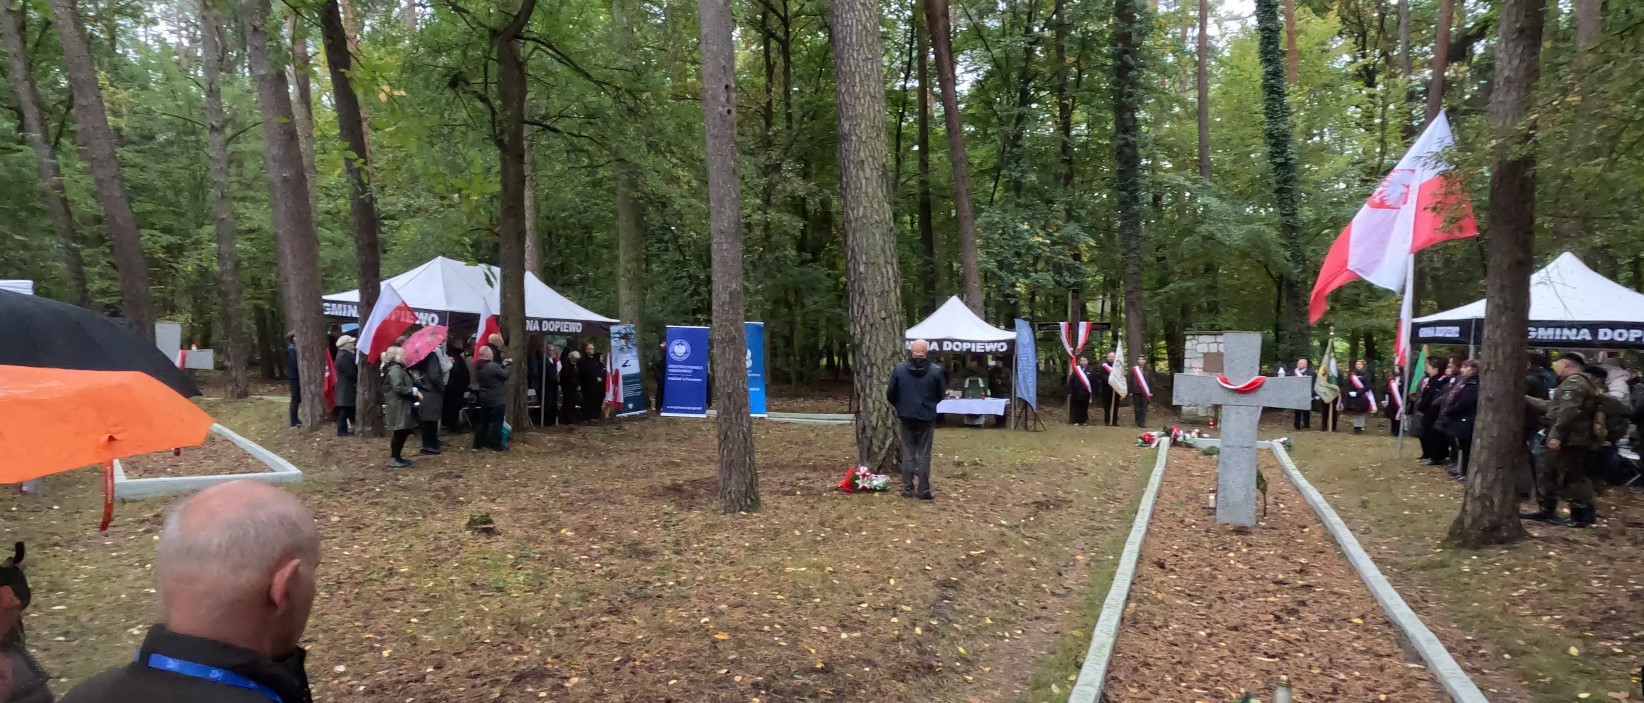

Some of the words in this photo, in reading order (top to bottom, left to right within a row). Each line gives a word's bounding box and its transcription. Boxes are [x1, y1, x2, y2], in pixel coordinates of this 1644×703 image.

[323, 302, 360, 318] GMIN
[541, 320, 583, 333] DOPIEWO
[1527, 326, 1593, 340] GMINA
[1597, 328, 1644, 342] DOP
[942, 341, 1008, 353] DOPIEWO
